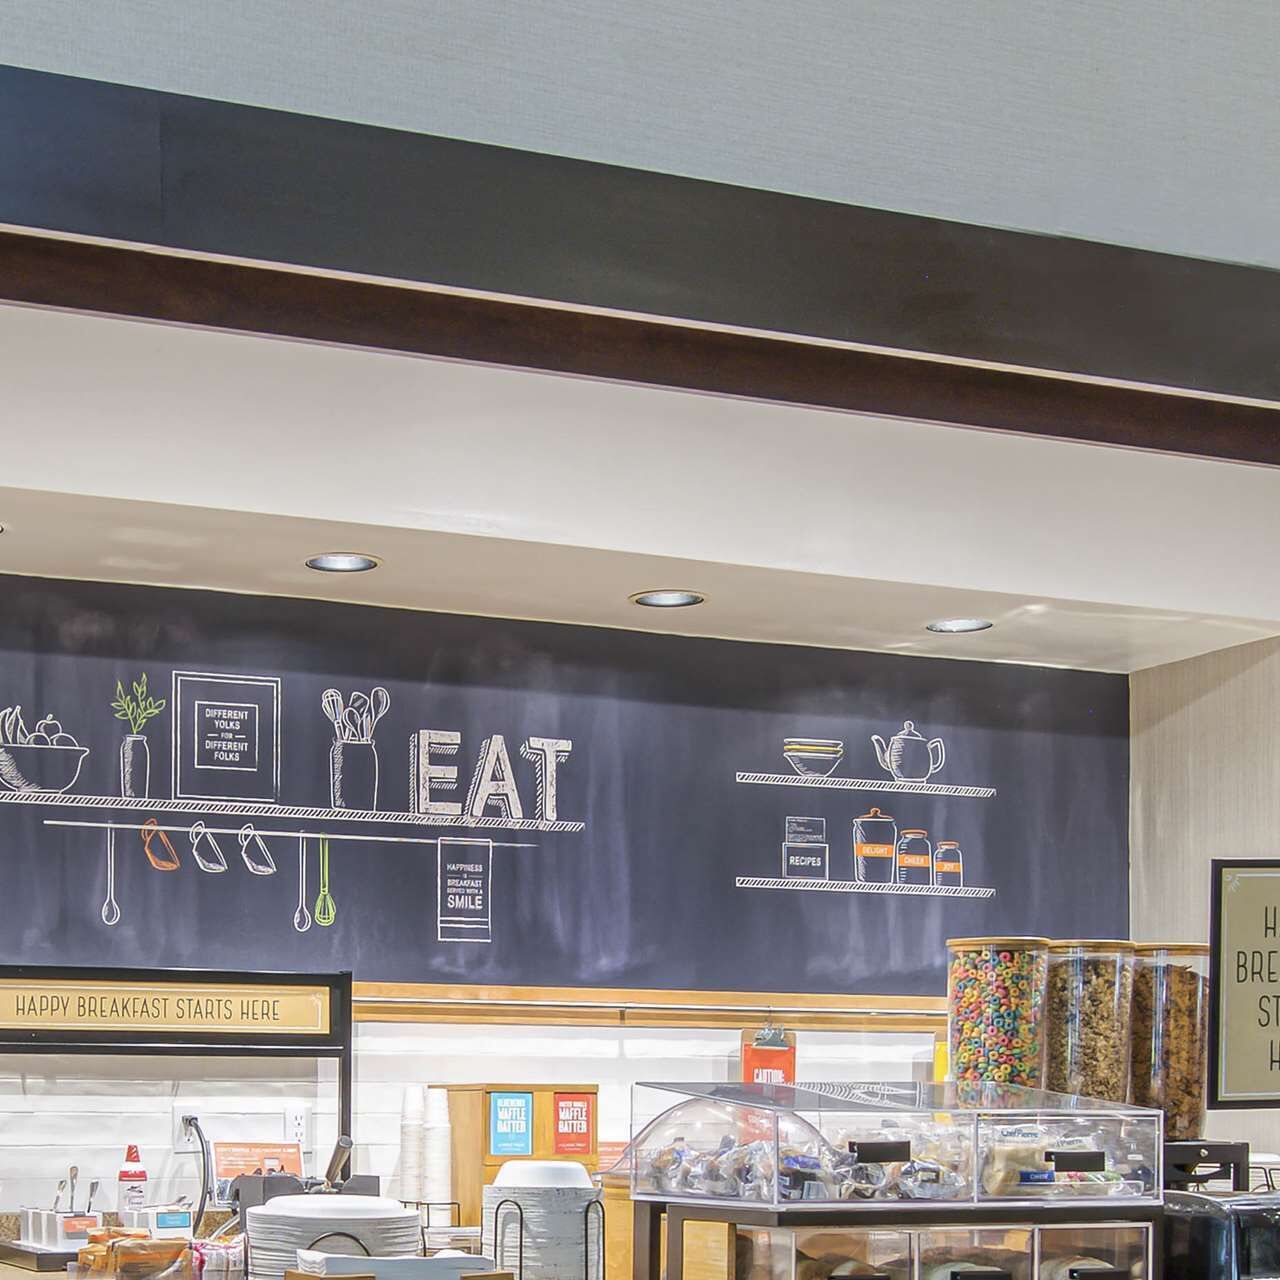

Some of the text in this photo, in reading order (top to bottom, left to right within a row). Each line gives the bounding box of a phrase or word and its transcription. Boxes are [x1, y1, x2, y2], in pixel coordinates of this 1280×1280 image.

[205, 708, 249, 720] DIFFERENT
[214, 719, 241, 730] YOLKS
[205, 740, 249, 751] DIFFERENT
[214, 751, 240, 761] FOLKS
[411, 729, 573, 822] EAT
[862, 846, 888, 856] DELIGHT
[789, 855, 822, 867] RECIPES
[447, 863, 483, 872] HAPPINESS
[448, 879, 482, 888] BREAKFAST
[447, 895, 483, 909] SMILE
[16, 994, 280, 1021] HAPPY BREAKFAST STARTS HERE
[497, 1107, 526, 1120] WAFFLE
[559, 1107, 587, 1120] WAFFLE
[558, 1120, 587, 1133] BATTER
